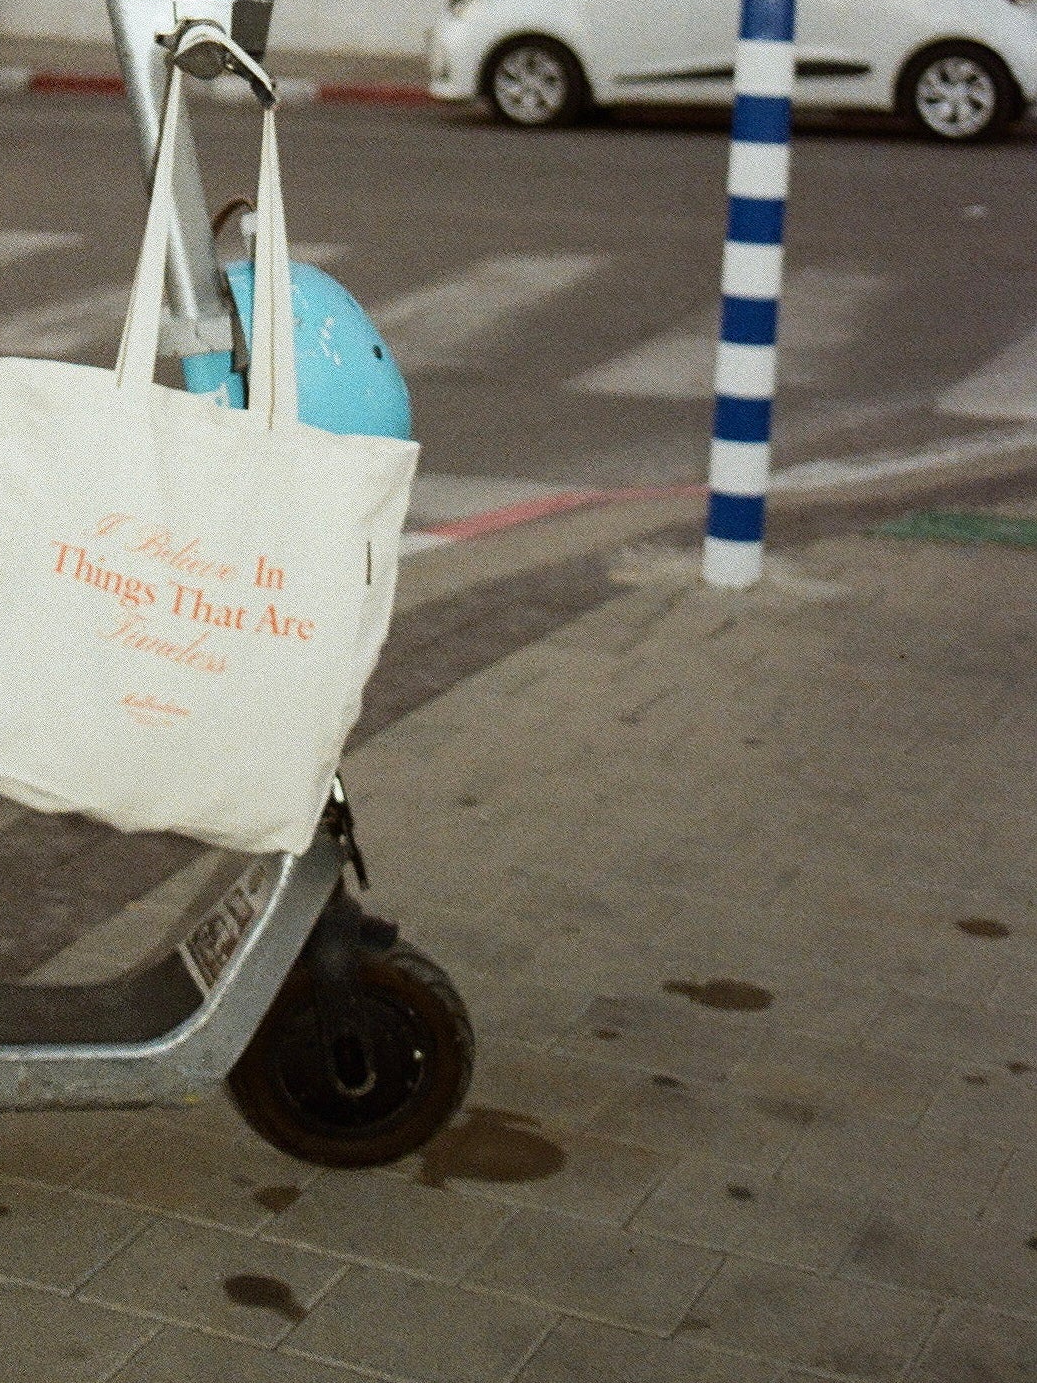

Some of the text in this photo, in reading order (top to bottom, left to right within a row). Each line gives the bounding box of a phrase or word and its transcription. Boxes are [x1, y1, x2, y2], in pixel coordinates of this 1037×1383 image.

[50, 538, 319, 644] Things That Are
[252, 553, 287, 591] In
[95, 612, 230, 674] Timeless
